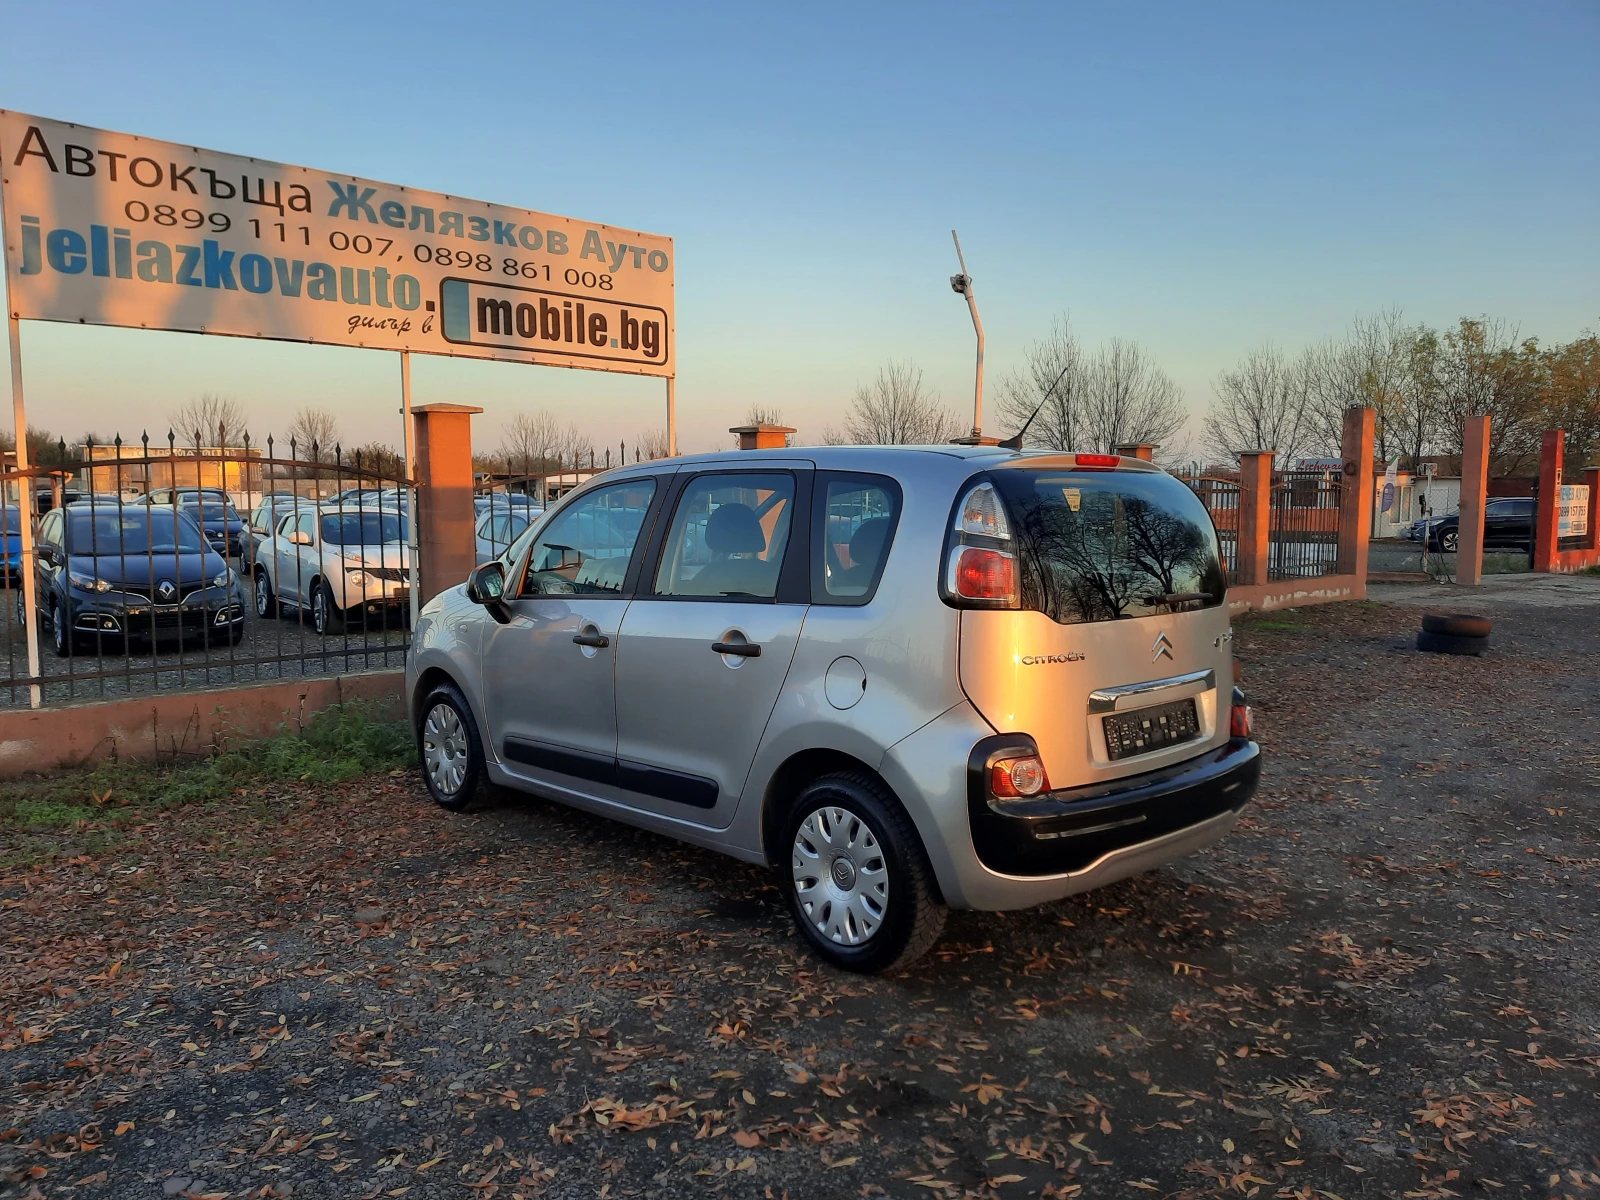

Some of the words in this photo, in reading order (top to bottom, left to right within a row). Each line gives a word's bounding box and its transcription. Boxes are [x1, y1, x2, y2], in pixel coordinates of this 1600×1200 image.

[13, 126, 312, 217] Автокъща
[326, 180, 569, 255] Желязков
[579, 229, 669, 273] Ауто
[124, 200, 232, 233] 0899
[248, 218, 310, 246] 111
[328, 231, 403, 262] 007,
[413, 244, 492, 272] 0898
[502, 258, 551, 281] 861
[564, 268, 614, 291] 008
[348, 315, 412, 337] дилър
[477, 297, 660, 358] mobile.bg
[1021, 651, 1086, 666] CITROËN
